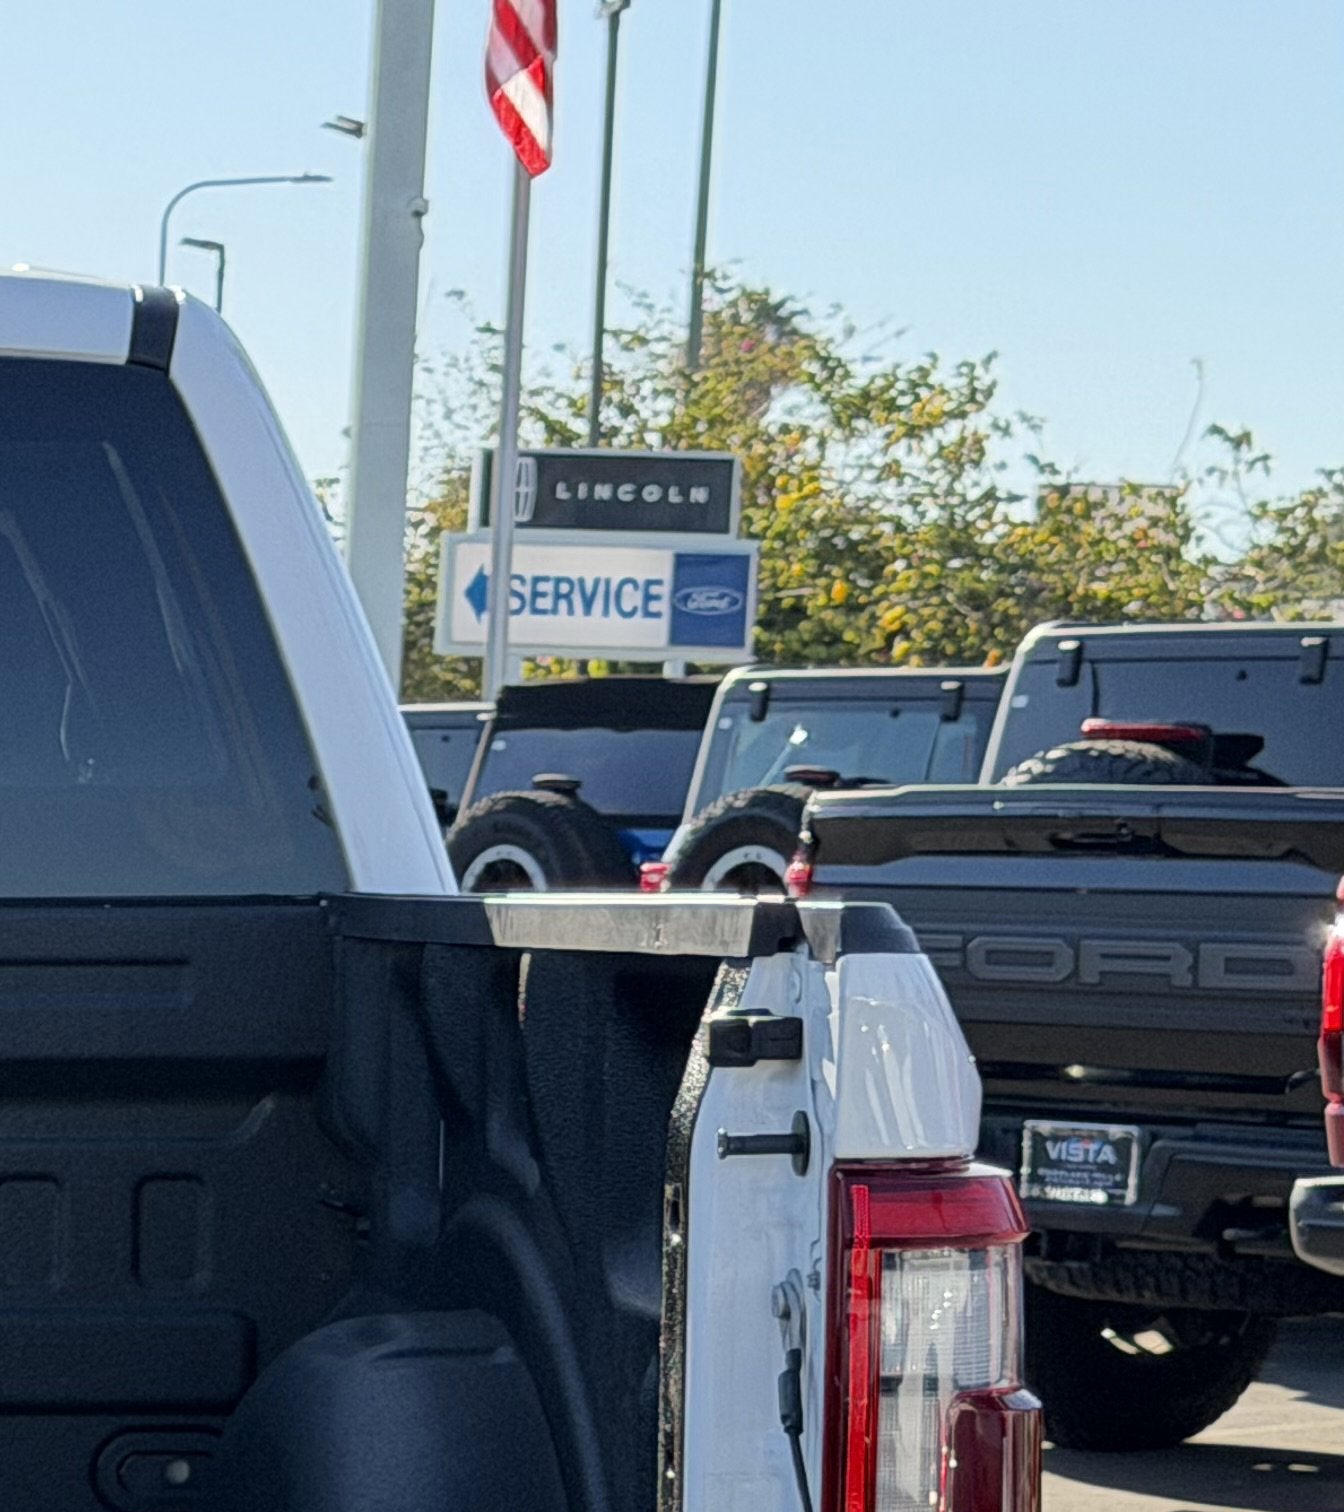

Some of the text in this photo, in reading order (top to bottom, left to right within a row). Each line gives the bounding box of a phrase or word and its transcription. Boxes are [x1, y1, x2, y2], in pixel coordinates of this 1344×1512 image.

[555, 482, 710, 505] LINCOLN
[510, 574, 663, 619] SERVICE
[1044, 1139, 1118, 1165] VISTA
